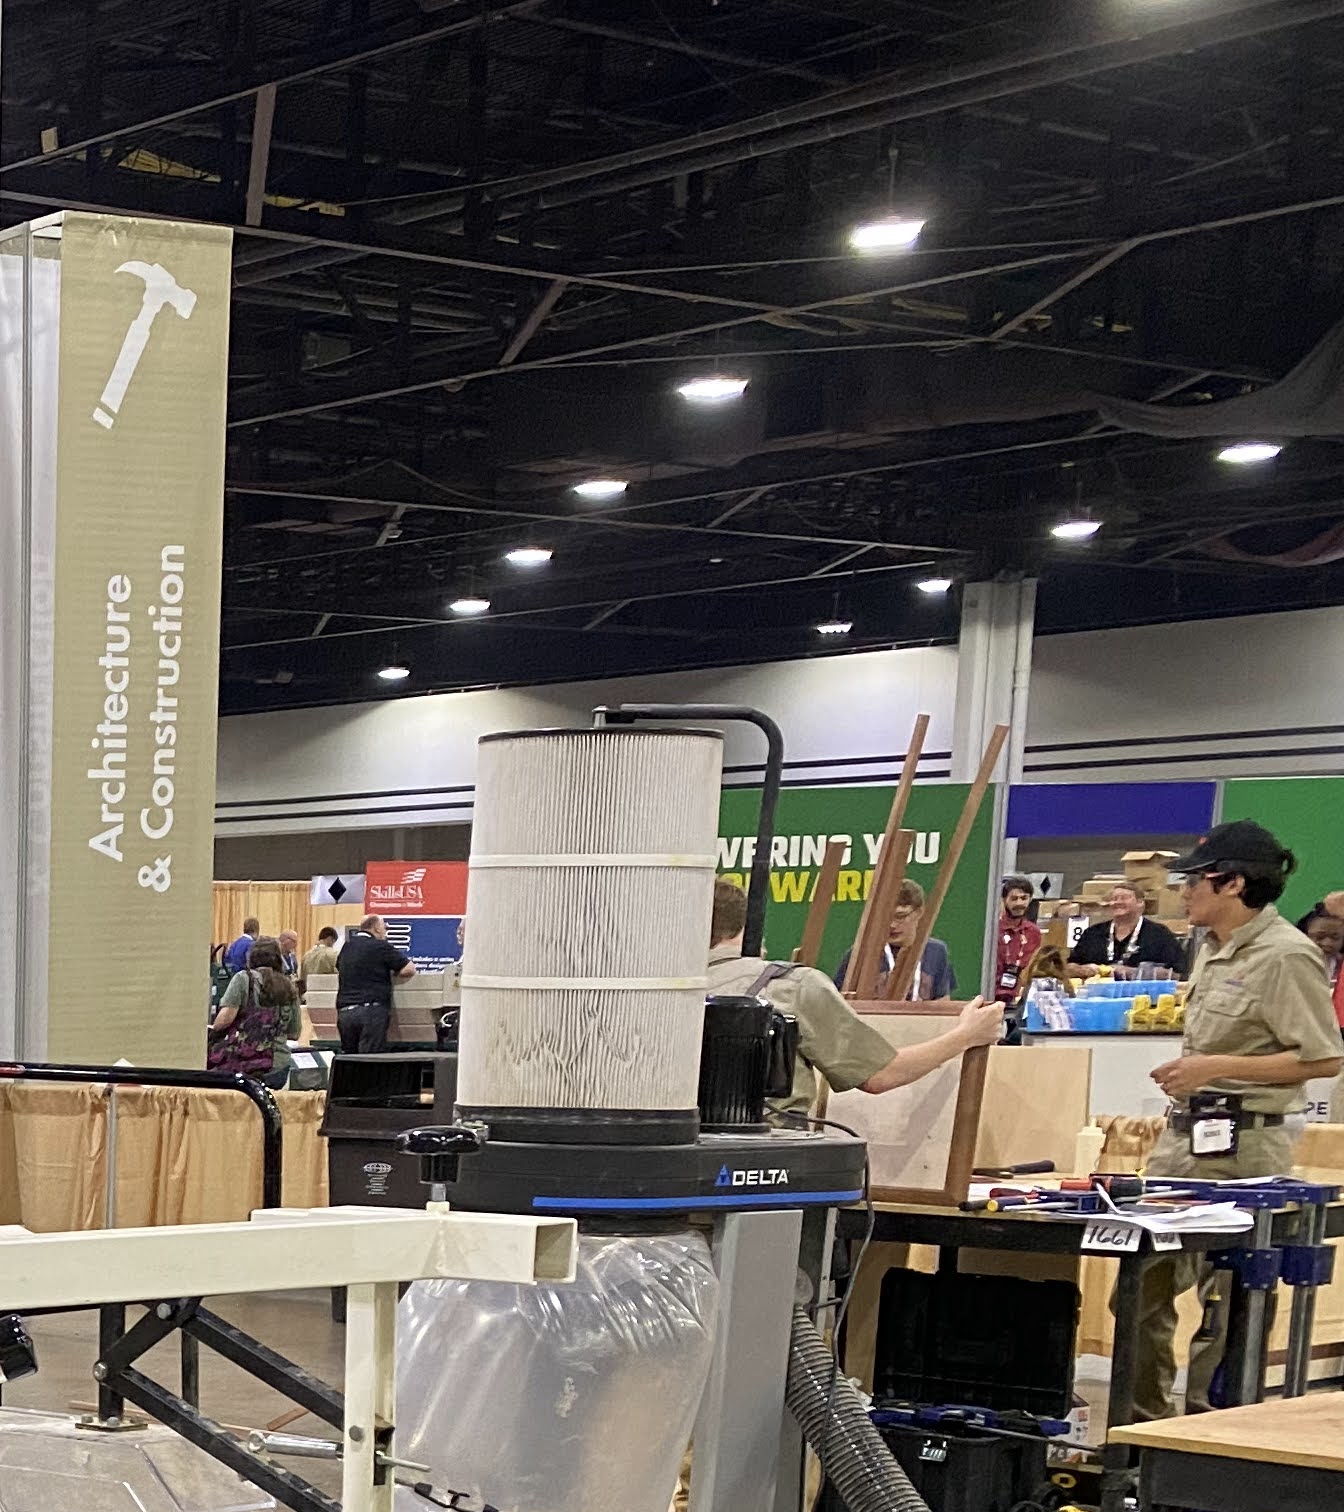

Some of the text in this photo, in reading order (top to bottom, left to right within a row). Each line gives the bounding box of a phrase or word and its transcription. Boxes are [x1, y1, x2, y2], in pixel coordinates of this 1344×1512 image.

[86, 575, 131, 862] Architecture
[137, 544, 185, 892] & Construction
[1073, 926, 1083, 942] 8
[732, 1169, 789, 1186] DELTA
[1087, 1225, 1135, 1246] 1661
